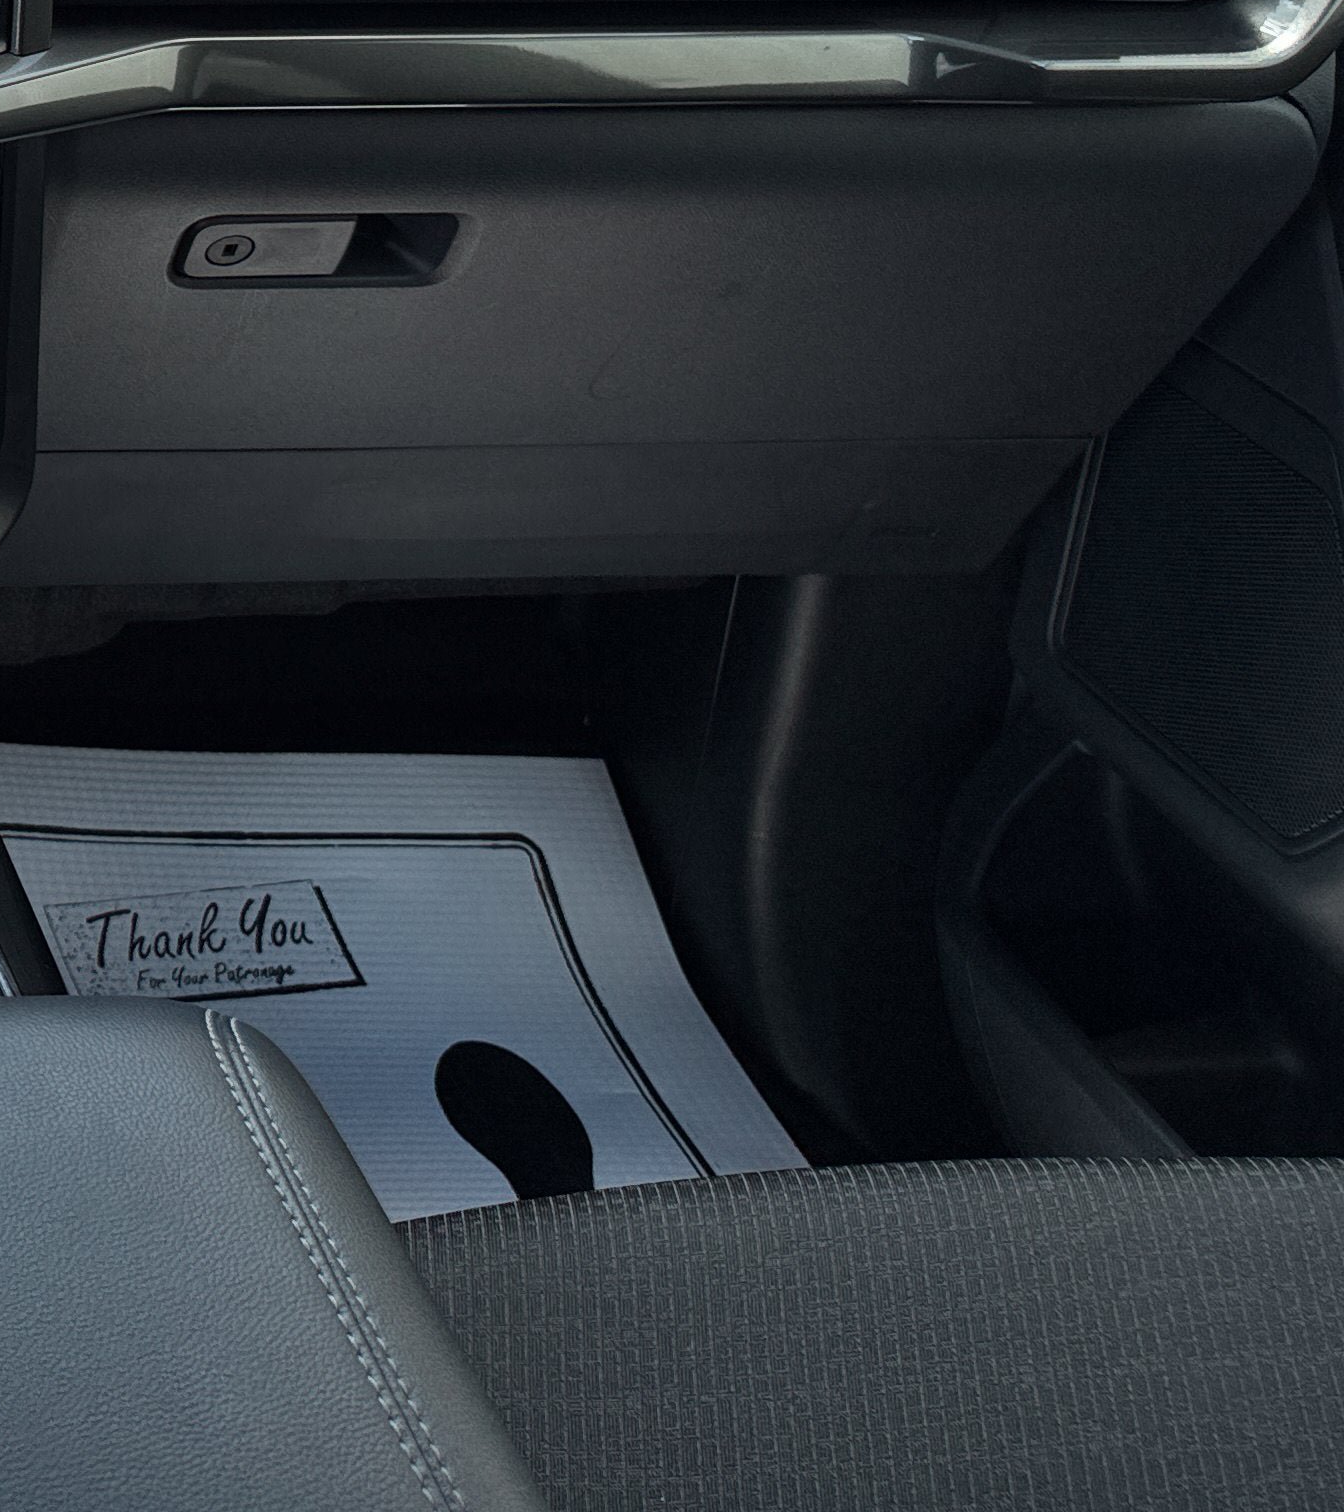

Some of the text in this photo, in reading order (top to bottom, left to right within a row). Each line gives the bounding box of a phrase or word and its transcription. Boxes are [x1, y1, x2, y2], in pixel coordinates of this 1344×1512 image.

[86, 893, 313, 968] Thank You
[136, 962, 295, 989] For Your Patronage
